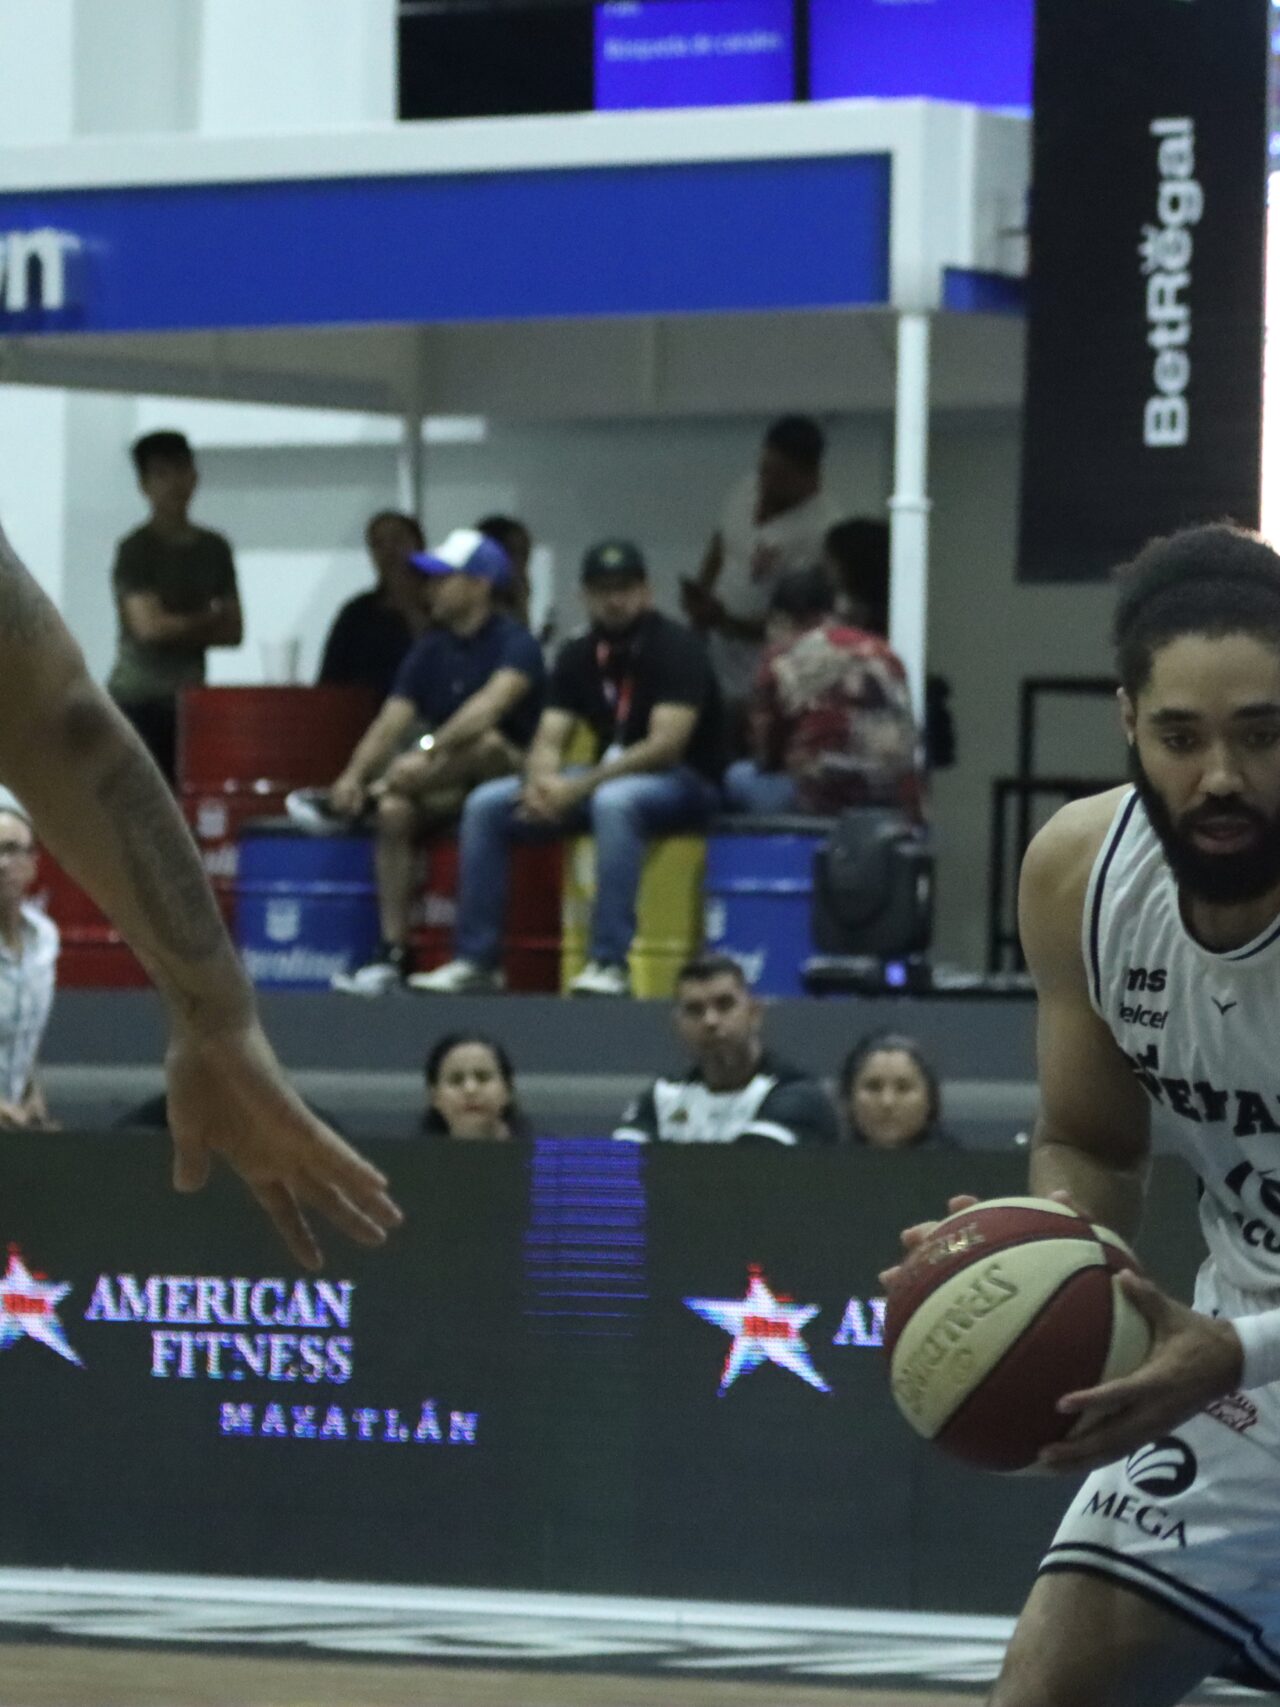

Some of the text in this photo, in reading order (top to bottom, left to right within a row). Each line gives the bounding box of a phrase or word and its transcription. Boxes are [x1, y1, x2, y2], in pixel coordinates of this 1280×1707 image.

[84, 1273, 356, 1328] AMERICAN
[151, 1330, 354, 1384] FITNESS
[1082, 1490, 1187, 1549] MEGA
